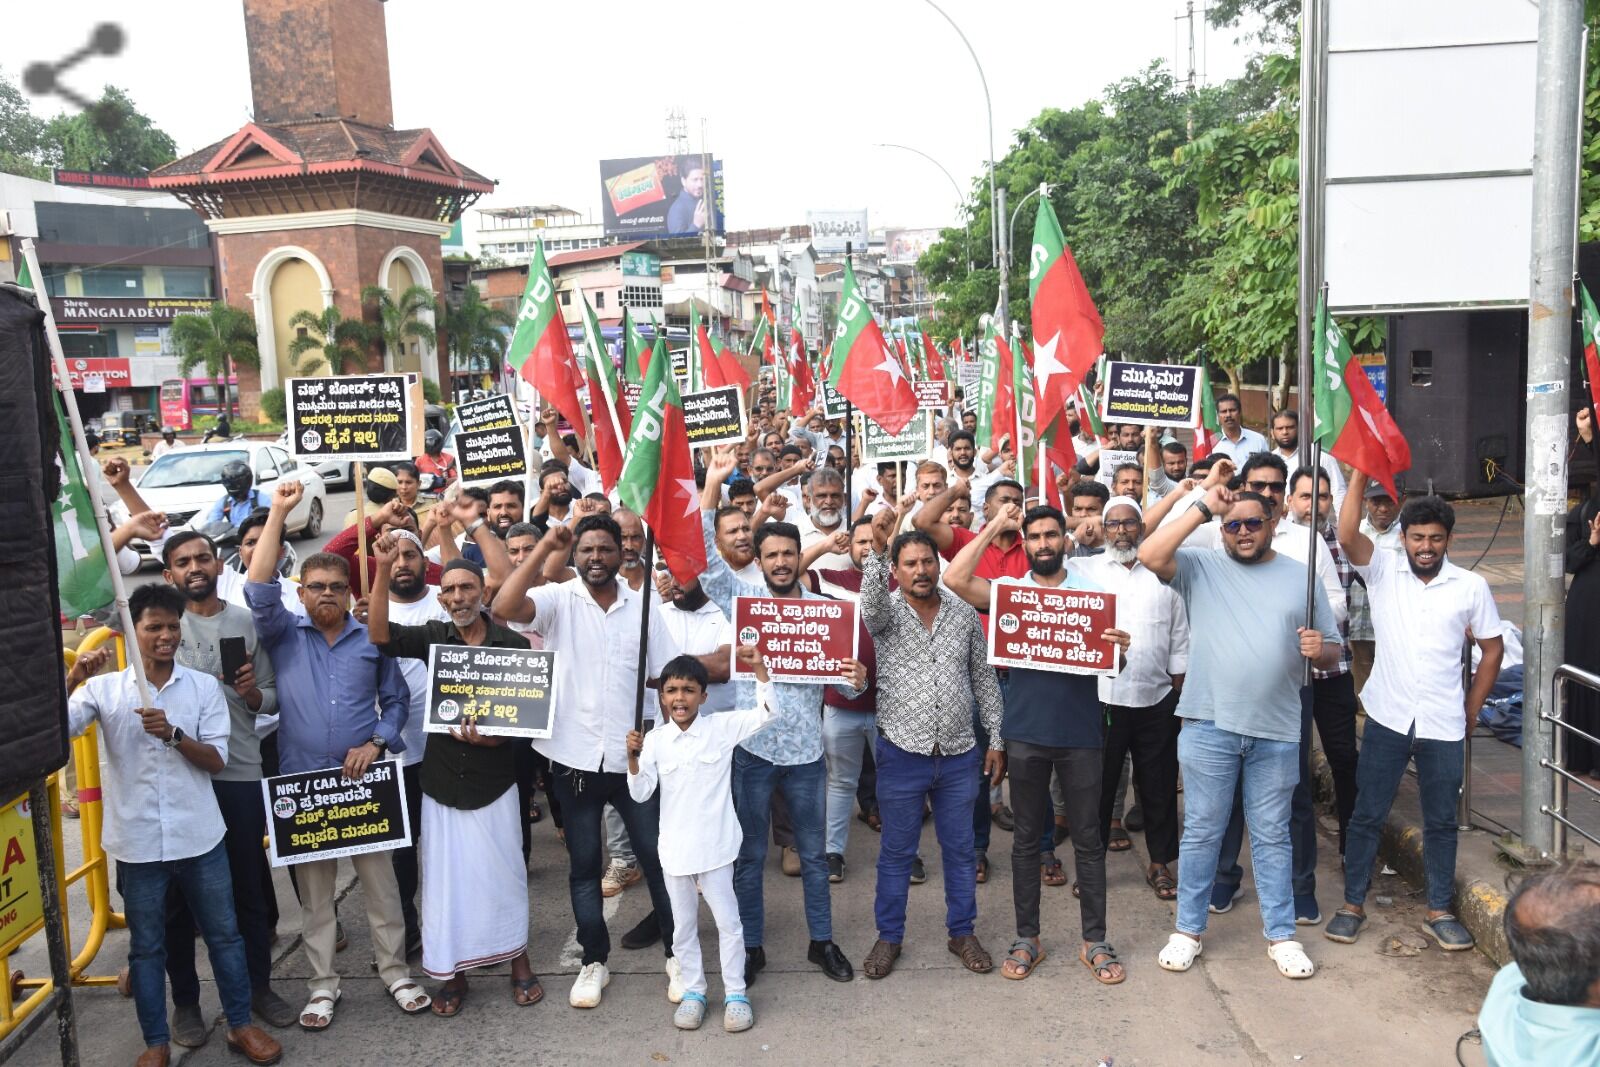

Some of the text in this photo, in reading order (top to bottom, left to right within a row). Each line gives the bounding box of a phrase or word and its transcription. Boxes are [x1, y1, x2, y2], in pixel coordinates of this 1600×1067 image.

[63, 308, 170, 318] MANGALADEVI
[1121, 368, 1184, 390] ಮುಸ್ಲಿಮರ
[329, 381, 376, 396] ಬೋರ್ಡ್
[378, 381, 401, 398] ಆಸ್ತಿ
[297, 399, 403, 413] ಮುಸ್ಲಿಮರು ದಾನ ನೀಡಿದ ಆಸ್ತಿ
[301, 414, 334, 428] ಅದರಲ್ಲಿ
[374, 413, 399, 423] ನಯಾ
[303, 435, 319, 444] SDPI
[353, 431, 378, 448] ಇಲ್ಲ
[1010, 590, 1104, 611] ನಮ್ಮ ಪ್ರಾಣಗಳು
[750, 601, 842, 622] ನಮ್ಮ ಪ್ರಾಣಗಳು
[1021, 609, 1092, 632] ಸಾಕಾಗಲಿಲ್ಲ
[762, 620, 831, 641] ಸಾಕಾಗಲಿಲ್ಲ
[1000, 618, 1017, 627] SDPI
[741, 632, 757, 640] SDPI
[1026, 626, 1087, 650] ಈಗ ನಮ್ಮ
[766, 638, 826, 660] ಈಗ ನಮ್ಮ
[474, 652, 524, 667] ಬೋರ್ಡ್
[526, 656, 548, 673] ಆಸ್ತಿ
[437, 669, 549, 688] ಮುಸ್ಲಿಮರು ದಾನ ನೀಡಿದ ಆಸ್ತಿ
[440, 684, 544, 699] ಅದರಲ್ಲಿ ಸರ್ಕಾರದ ನಯಾ
[440, 705, 458, 713] SDPI
[494, 704, 518, 723] ಇಲ್ಲ
[276, 782, 301, 796] NRC
[304, 780, 311, 794] /
[313, 777, 338, 791] CAA
[276, 803, 294, 811] SDPI
[300, 787, 372, 812] ಪ್ರತೀಕಾರವೇ
[327, 802, 380, 821] ಬೋರ್ಡ್
[290, 818, 389, 849] ತಿದ್ದುಪಡಿ ಮಸೂದೆ
